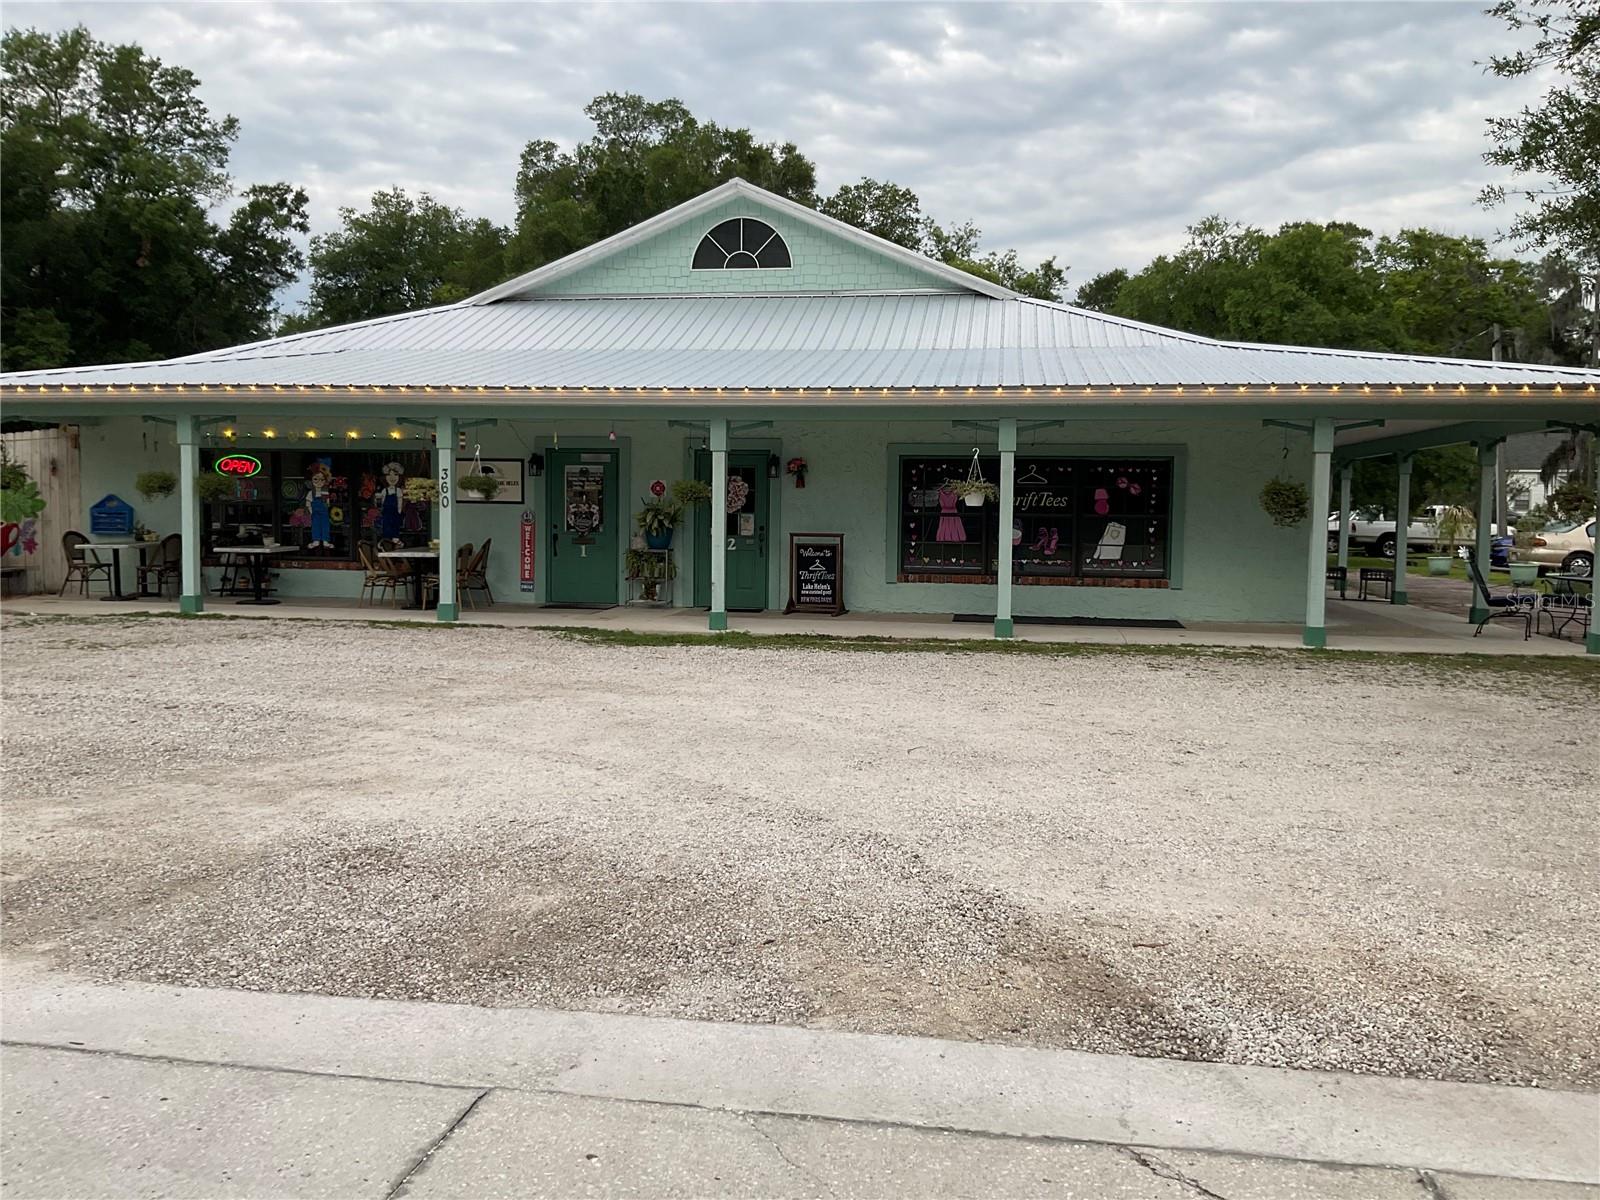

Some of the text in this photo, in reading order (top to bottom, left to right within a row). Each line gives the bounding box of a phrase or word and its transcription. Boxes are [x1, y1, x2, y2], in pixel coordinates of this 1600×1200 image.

[221, 459, 256, 474] OPEN
[441, 468, 449, 508] 360
[580, 545, 587, 558] 1
[727, 538, 737, 550] 2
[524, 526, 532, 578] WELCOME
